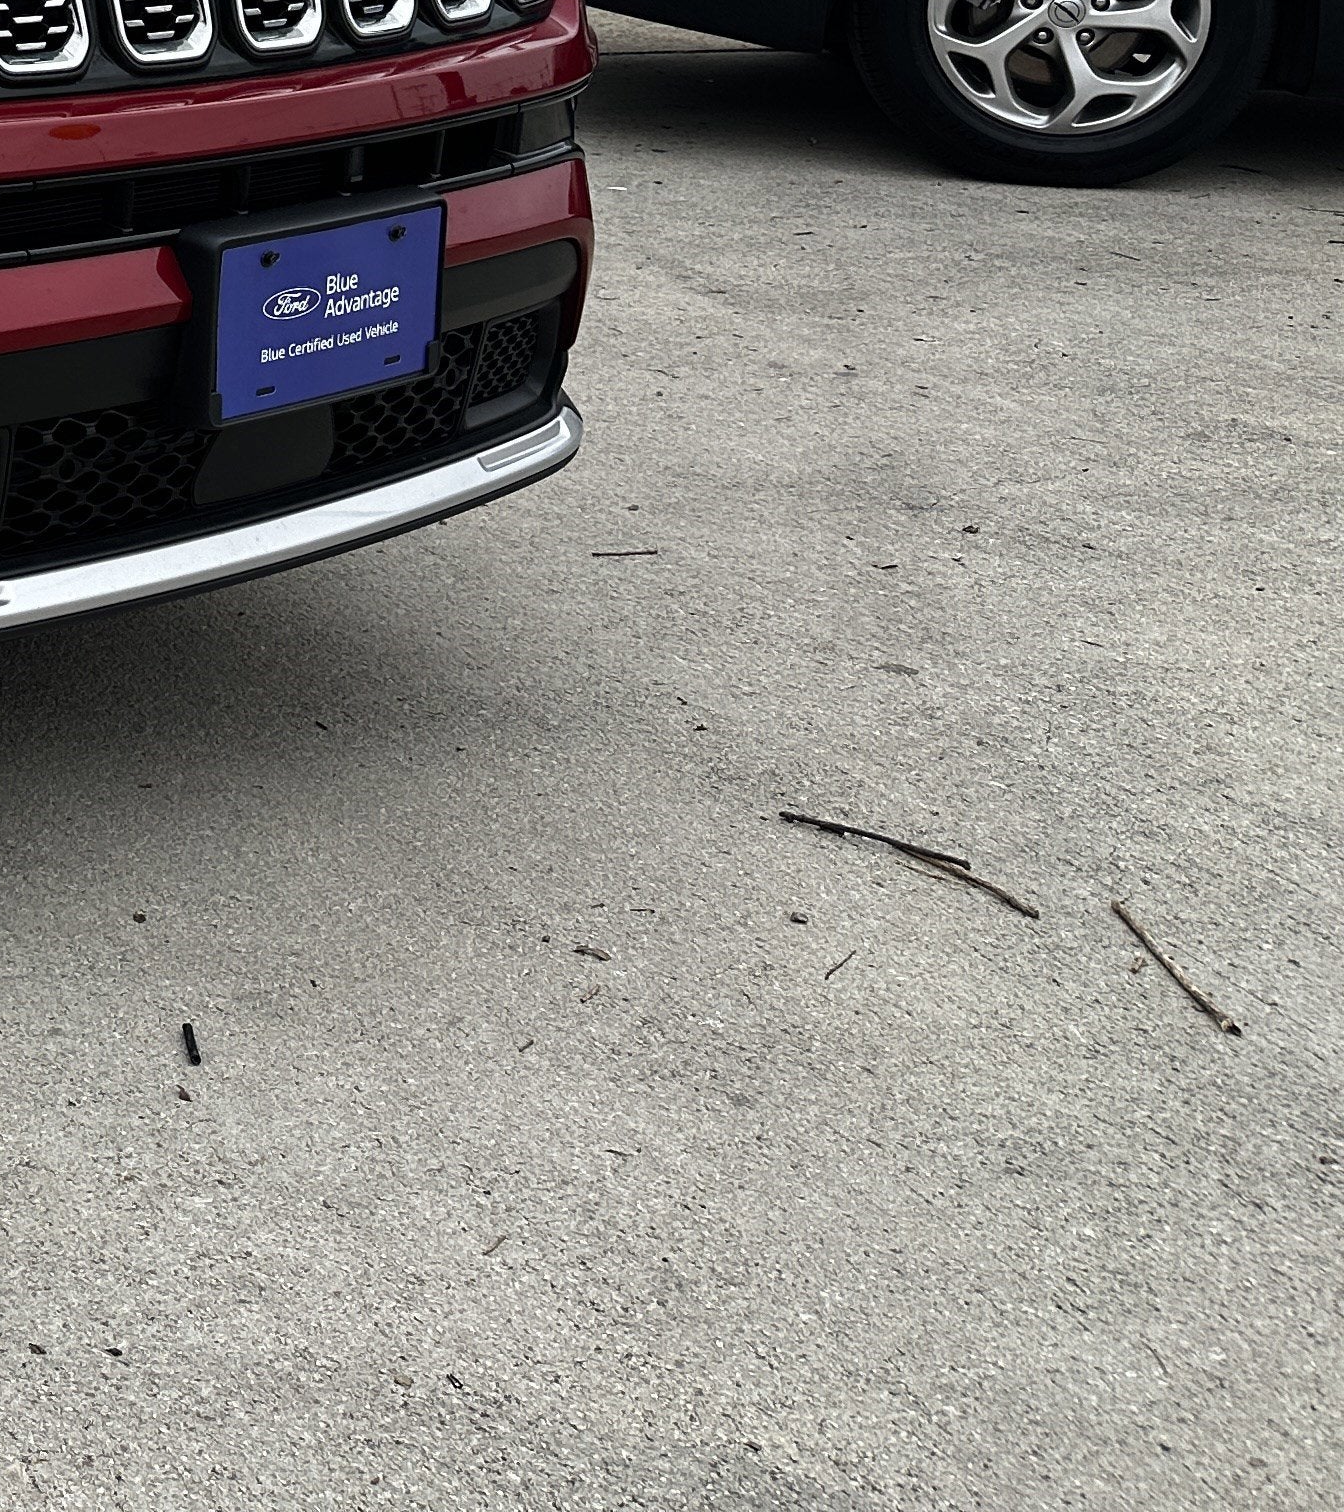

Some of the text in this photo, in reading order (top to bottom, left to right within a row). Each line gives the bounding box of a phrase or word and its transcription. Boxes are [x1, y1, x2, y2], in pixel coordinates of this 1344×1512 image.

[326, 273, 358, 295] Blue
[273, 293, 311, 316] Ford
[324, 286, 399, 319] Advantage
[260, 320, 399, 363] Blue Certified Used Vehicle
